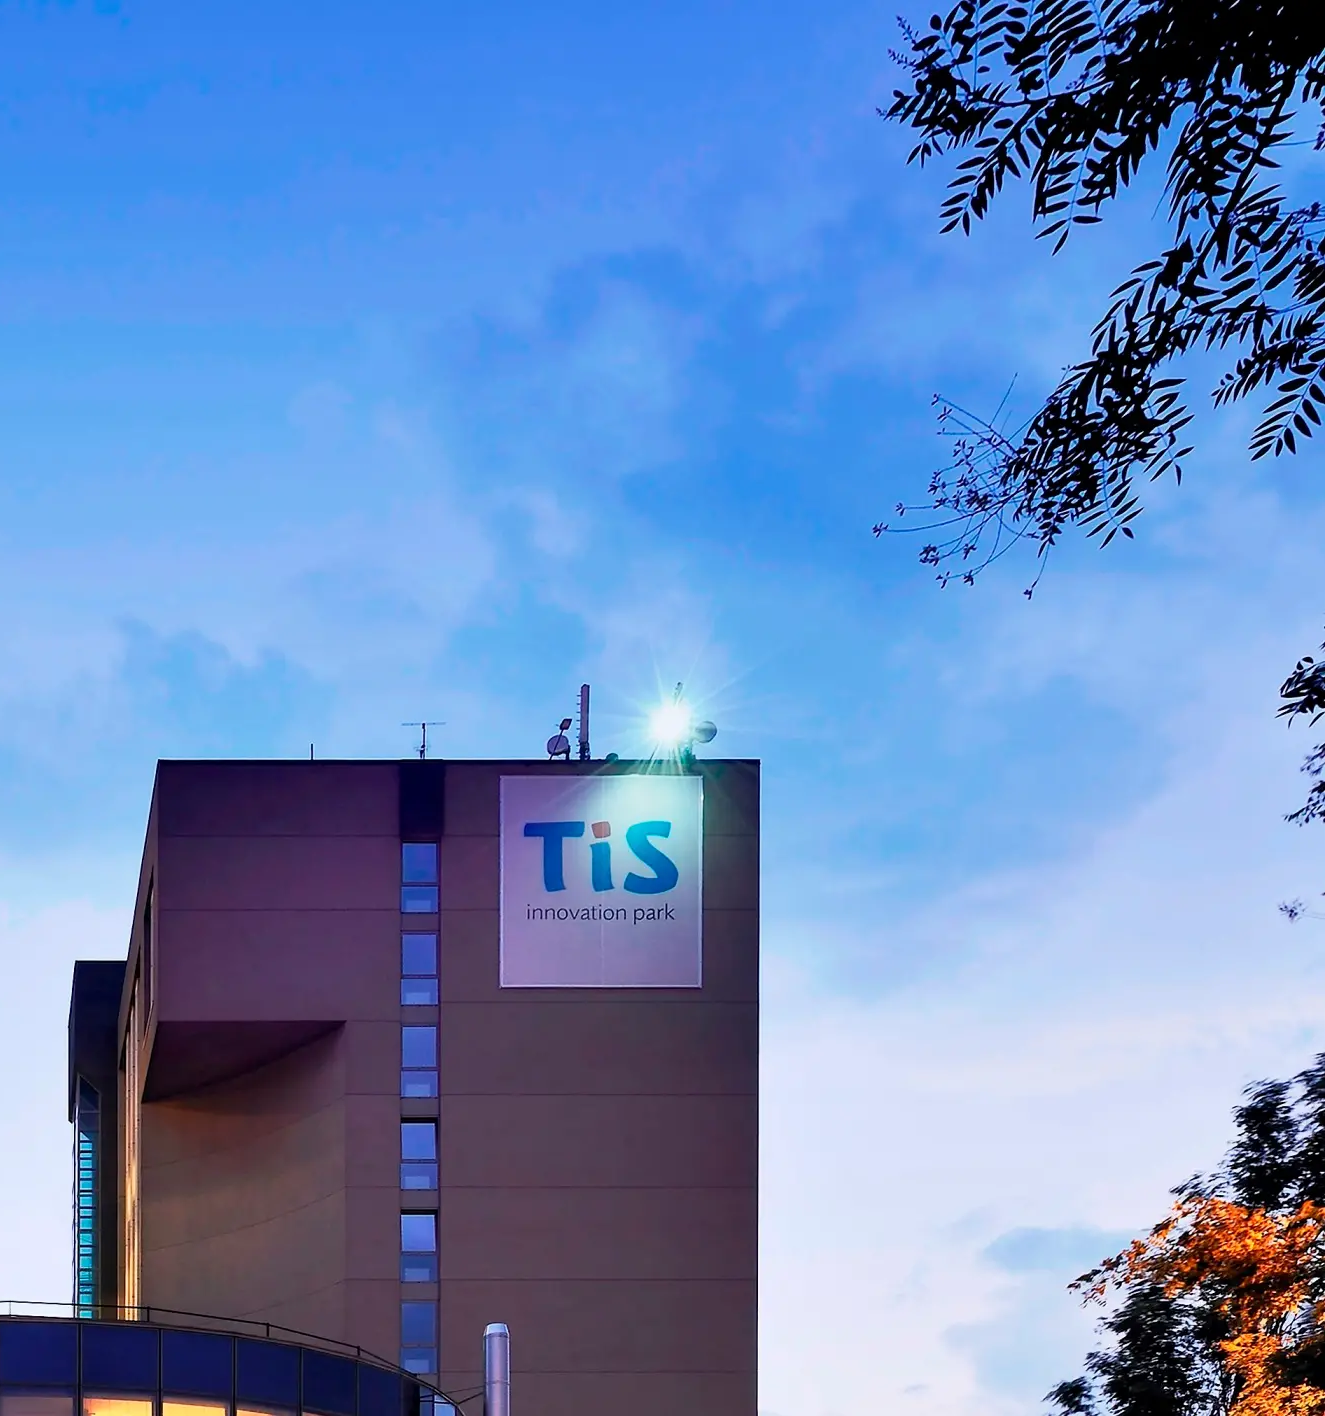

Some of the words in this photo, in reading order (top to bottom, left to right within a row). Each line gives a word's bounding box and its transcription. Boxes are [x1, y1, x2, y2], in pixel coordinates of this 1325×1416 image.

[523, 820, 679, 895] TiS
[526, 903, 627, 921] innovation
[633, 903, 675, 925] park
